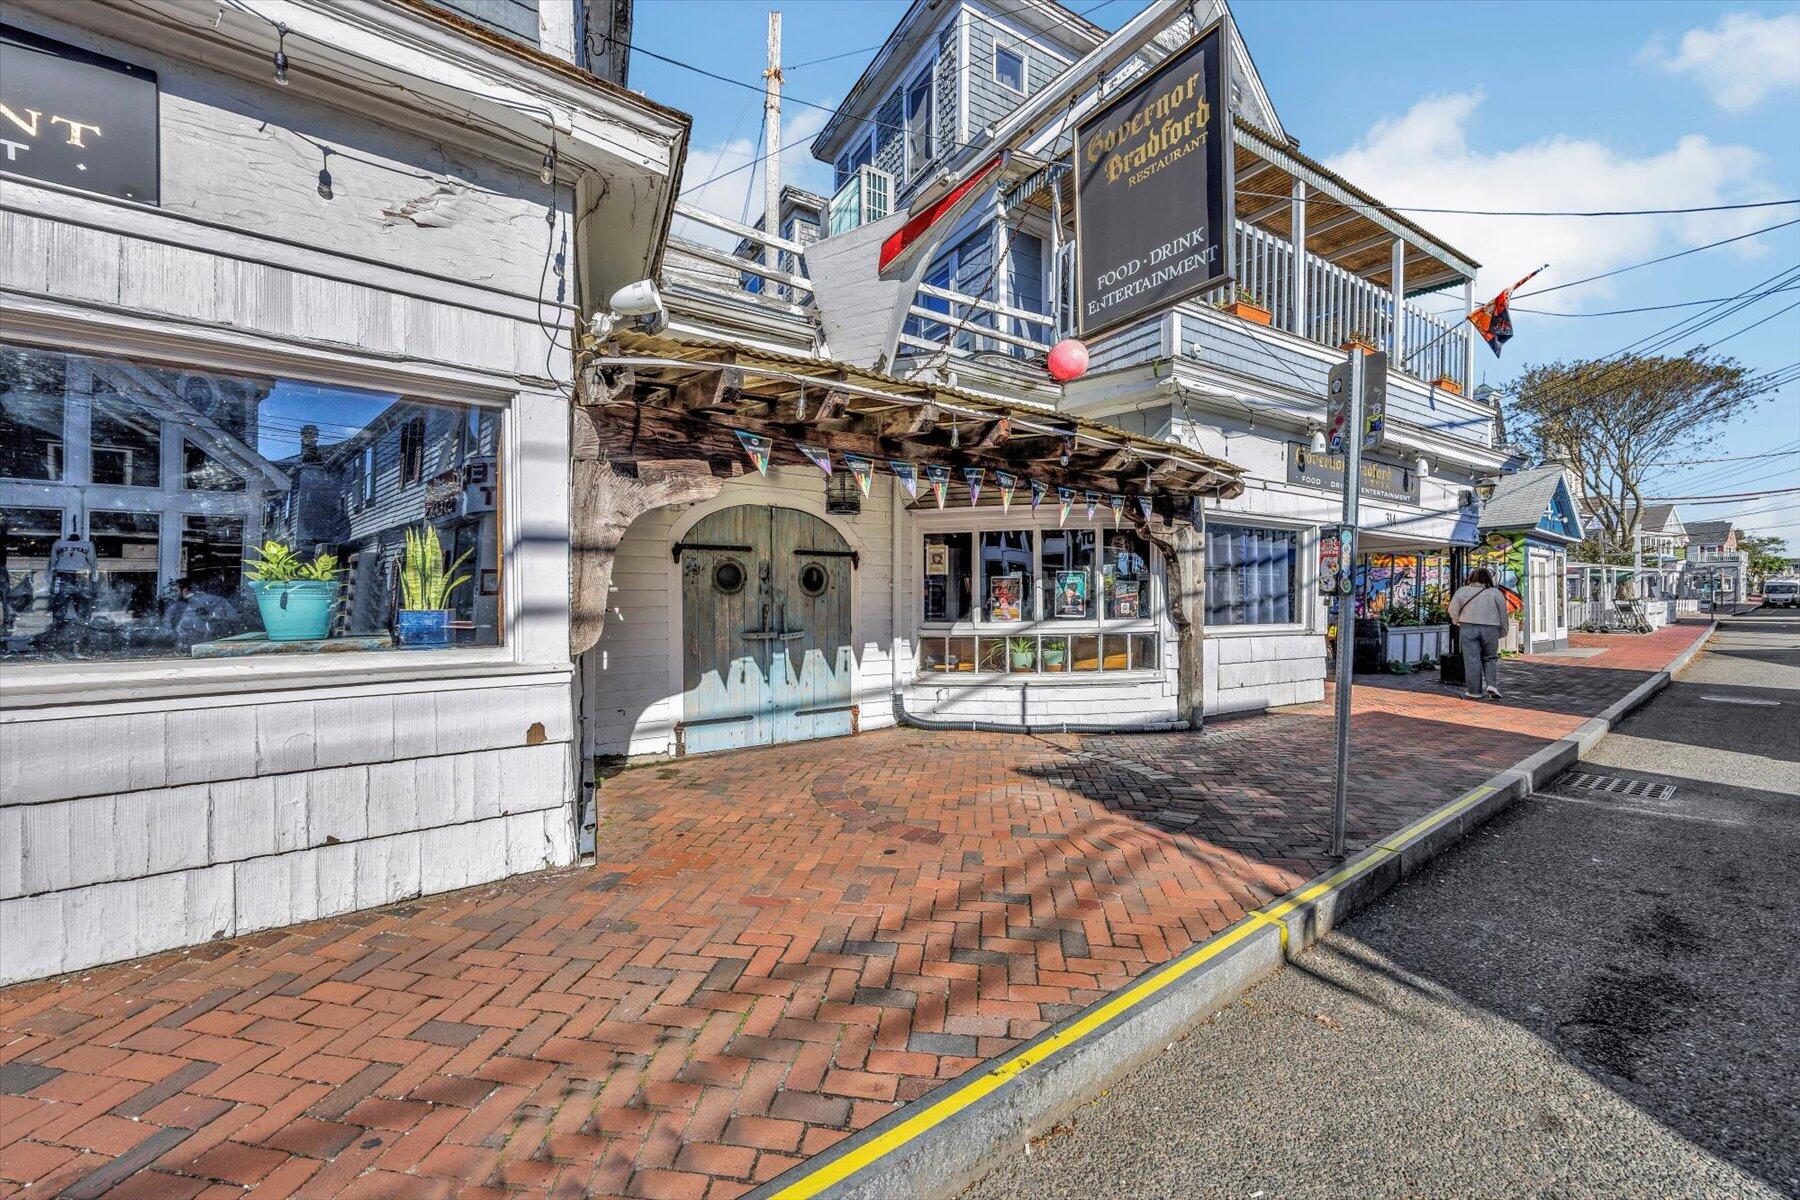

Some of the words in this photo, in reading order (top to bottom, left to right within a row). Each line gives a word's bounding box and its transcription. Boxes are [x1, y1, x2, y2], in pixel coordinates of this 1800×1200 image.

[1086, 71, 1201, 163] Governor
[1104, 94, 1210, 186] Bradford
[1128, 131, 1208, 190] RESTAURANT
[1087, 244, 1219, 316] ENTERTAINMENT
[1097, 259, 1141, 291] FOOD
[1149, 226, 1205, 266] DRINK
[1301, 475, 1321, 485] FOOD
[1330, 480, 1344, 489] DRI
[1361, 487, 1412, 501] ENTERTAINMENT
[1385, 512, 1397, 527] 314
